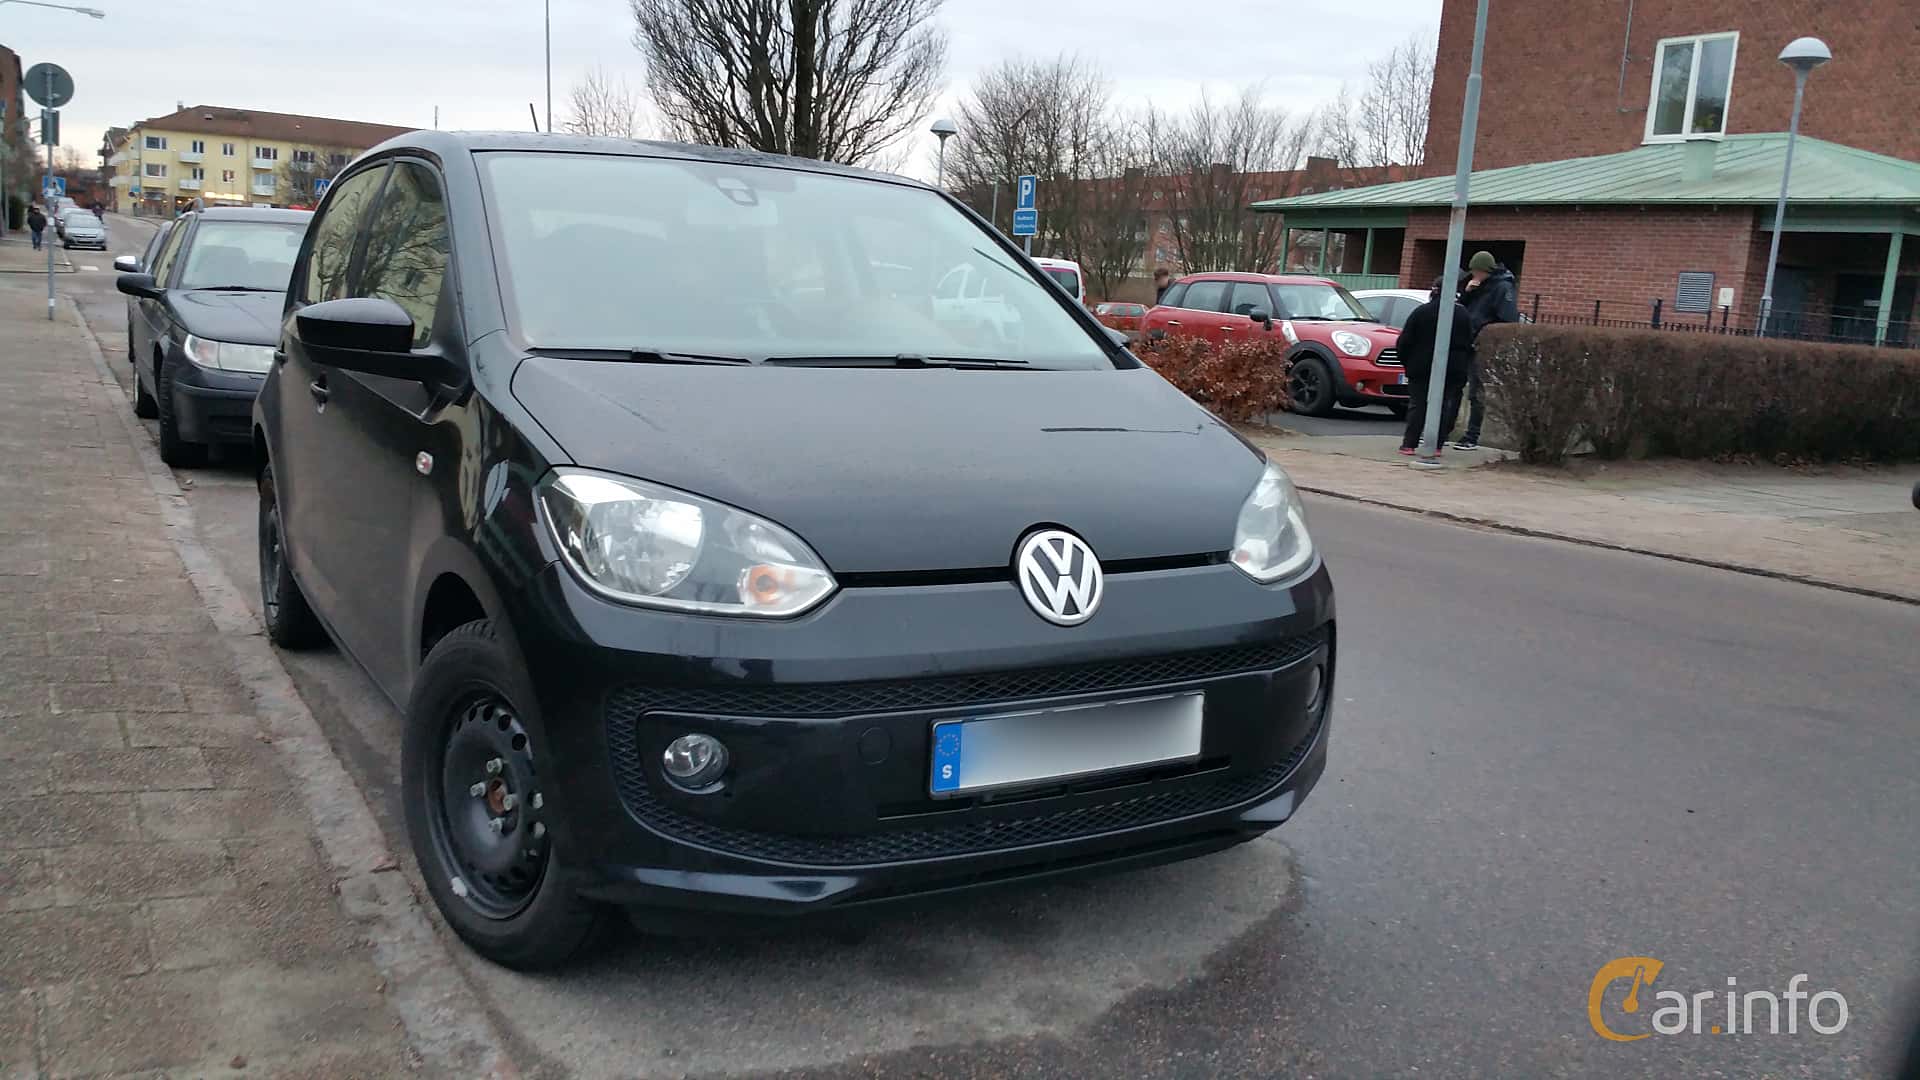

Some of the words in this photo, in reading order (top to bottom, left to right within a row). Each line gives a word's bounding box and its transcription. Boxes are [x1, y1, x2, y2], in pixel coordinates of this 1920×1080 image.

[1021, 179, 1032, 206] P
[1019, 530, 1104, 625] VW
[942, 764, 953, 779] S
